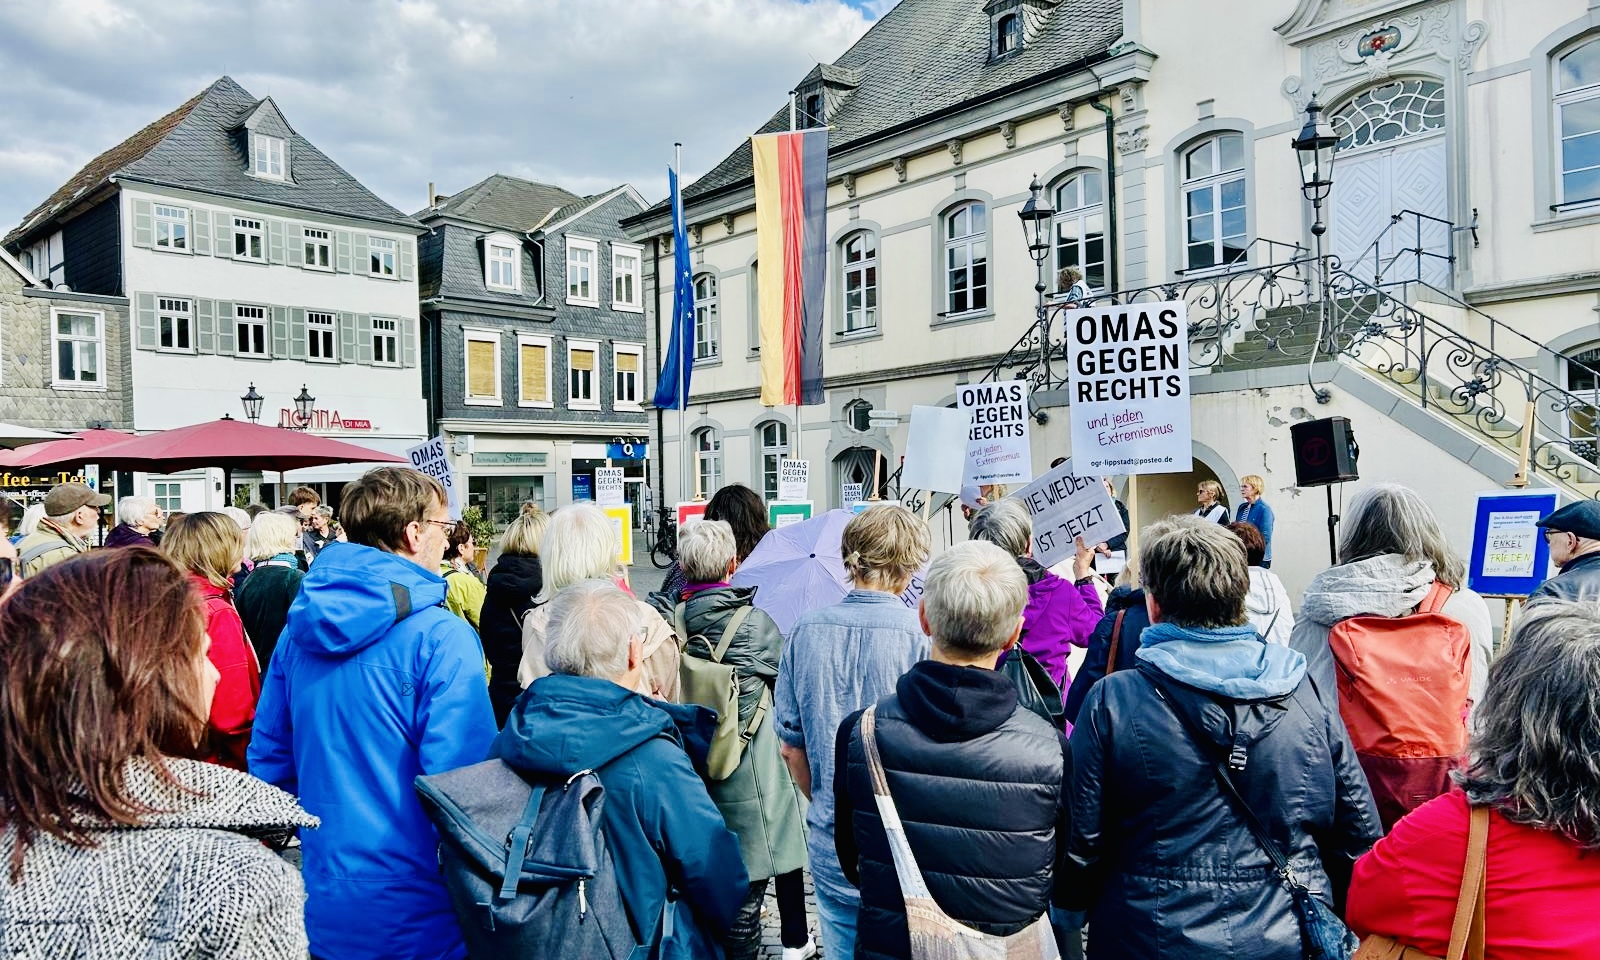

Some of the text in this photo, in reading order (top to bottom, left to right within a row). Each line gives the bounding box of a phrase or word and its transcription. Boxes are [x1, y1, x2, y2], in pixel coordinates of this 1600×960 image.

[1076, 309, 1178, 344] OMAS
[1076, 344, 1179, 375] GEGEN
[962, 385, 1022, 406] OMAS
[1077, 375, 1181, 402] RECHTS
[971, 405, 1022, 424] EGEN
[1087, 409, 1145, 430] und jeden
[1098, 423, 1174, 446] Extremismus
[411, 441, 444, 466] OMAS
[970, 444, 1003, 457] und jeden
[976, 452, 1020, 467] Extremismus
[417, 459, 449, 477] EGEN
[783, 461, 807, 469] OMAS
[1091, 456, 1173, 467] ogr-lippstadt@posteo.de
[1035, 503, 1103, 554] IST JETZT
[1490, 553, 1532, 562] FRIEDEN
